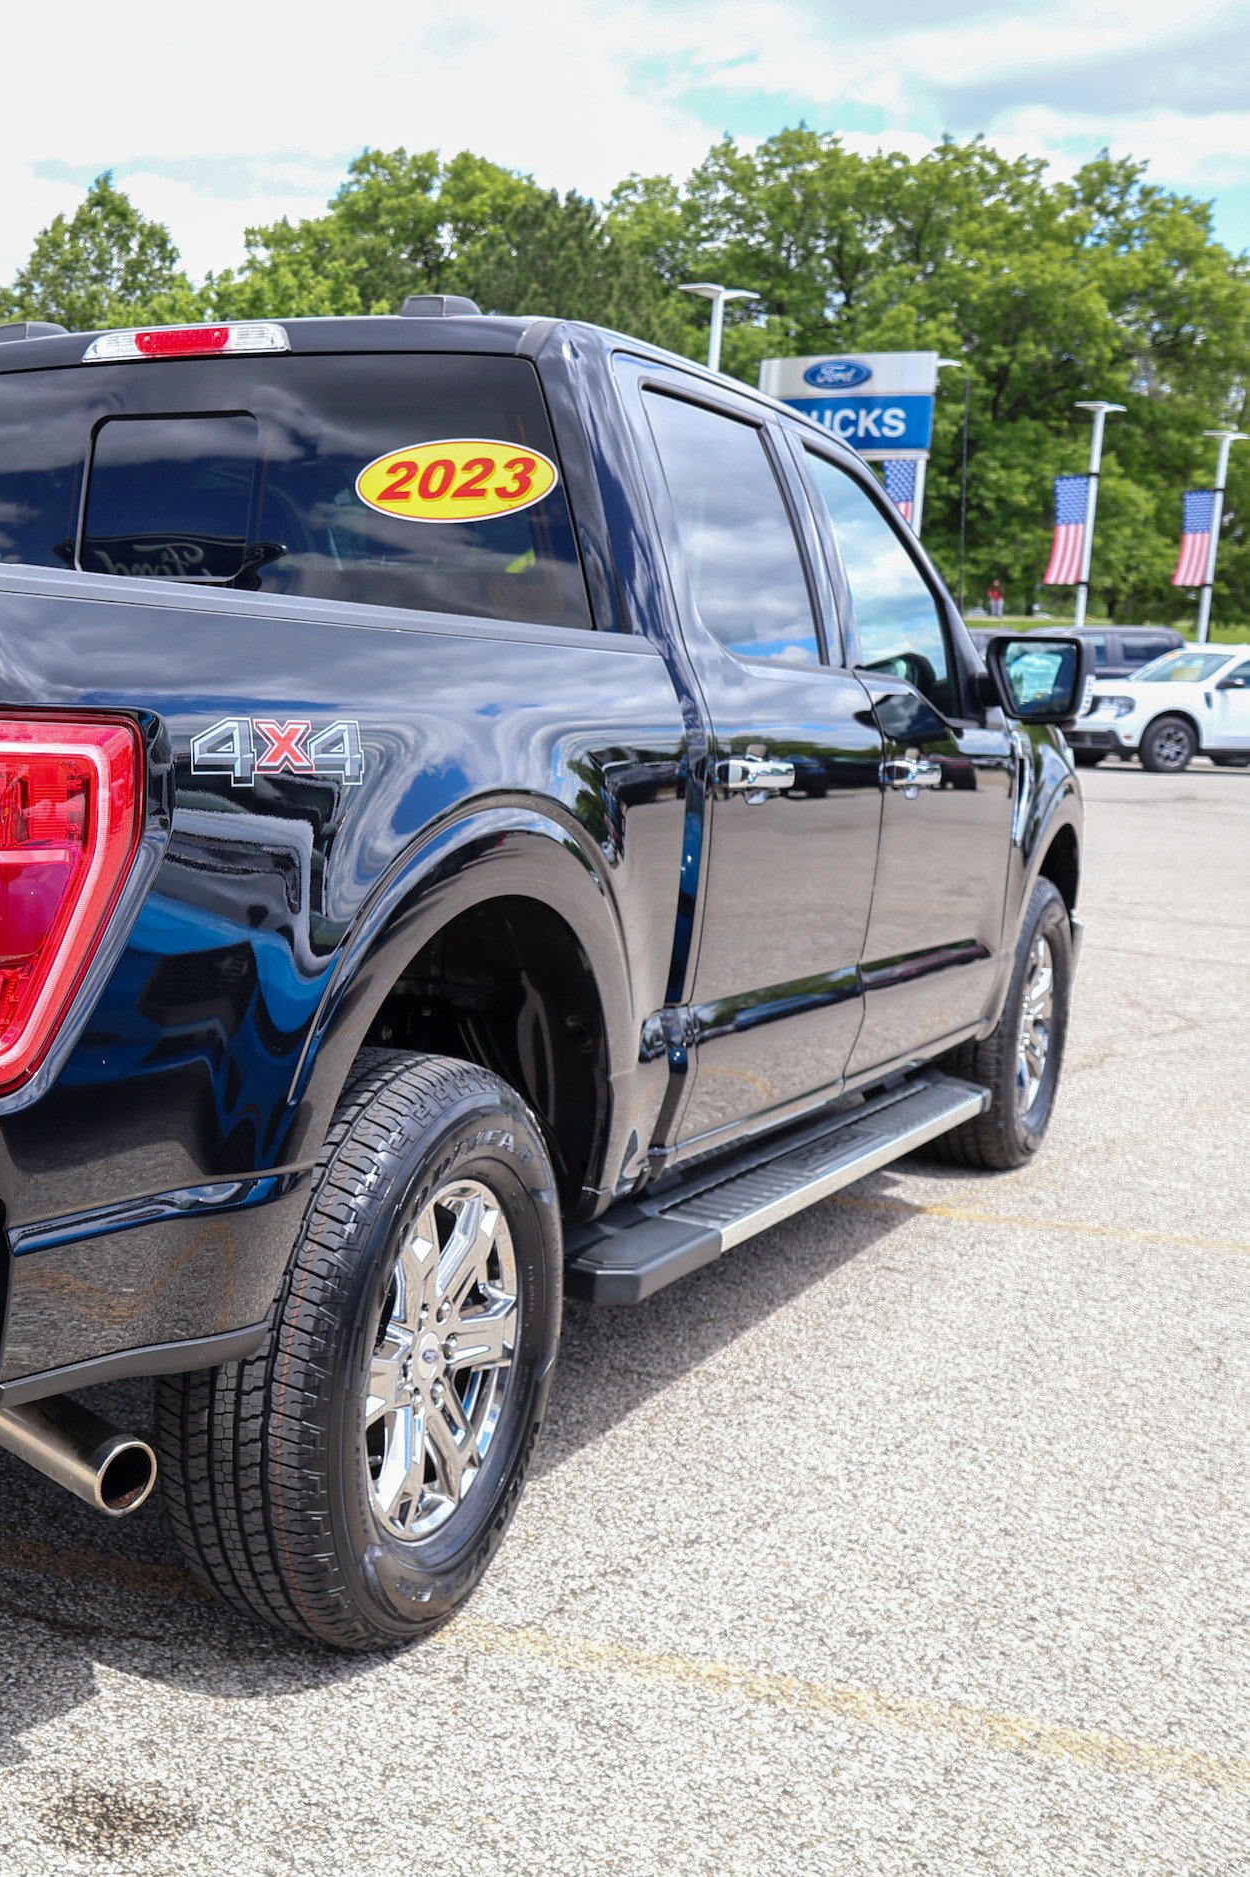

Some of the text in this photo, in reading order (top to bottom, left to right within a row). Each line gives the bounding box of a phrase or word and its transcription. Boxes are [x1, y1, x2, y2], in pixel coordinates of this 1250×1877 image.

[816, 364, 856, 383] Ford
[801, 407, 906, 438] UCKS
[377, 457, 537, 502] 2023
